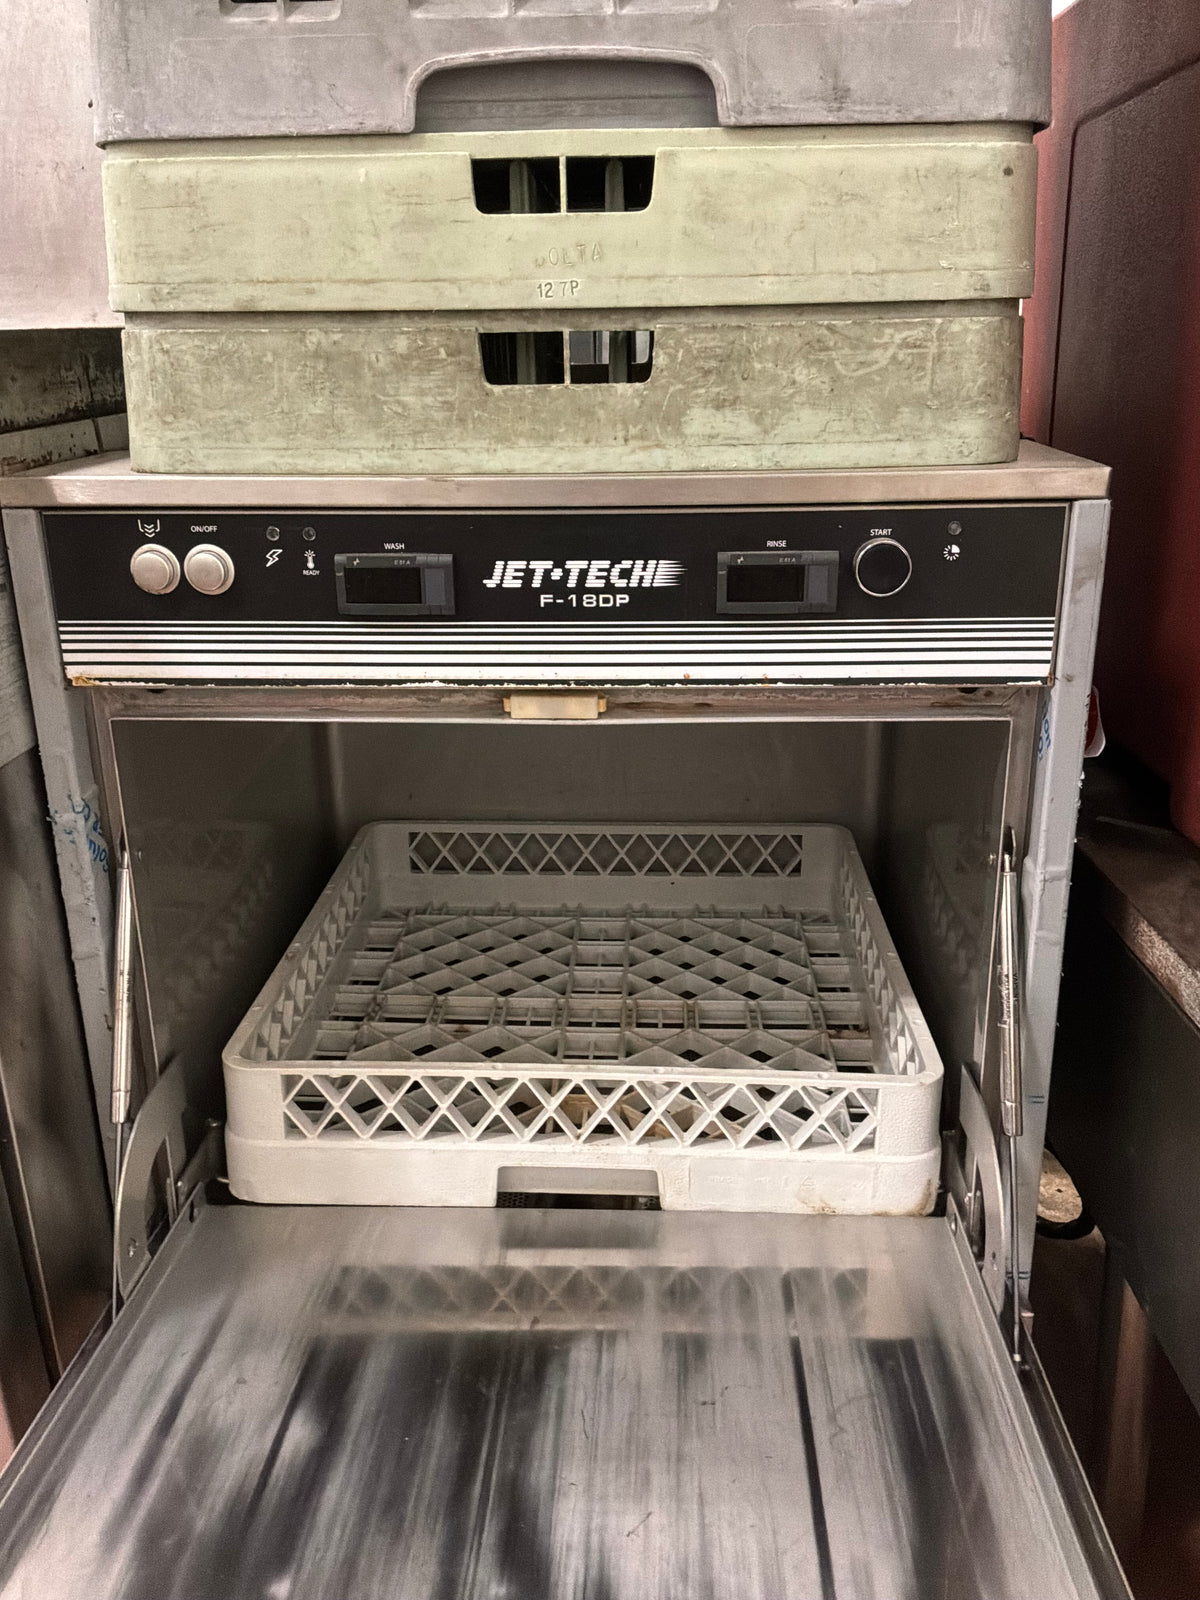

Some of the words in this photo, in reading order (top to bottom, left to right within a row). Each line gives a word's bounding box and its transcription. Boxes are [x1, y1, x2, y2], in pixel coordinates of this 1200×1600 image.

[190, 525, 218, 533] ON/OFF
[870, 528, 893, 536] START
[384, 542, 406, 550] WASH
[766, 540, 788, 548] RINSE
[539, 594, 630, 608] F-18DP
